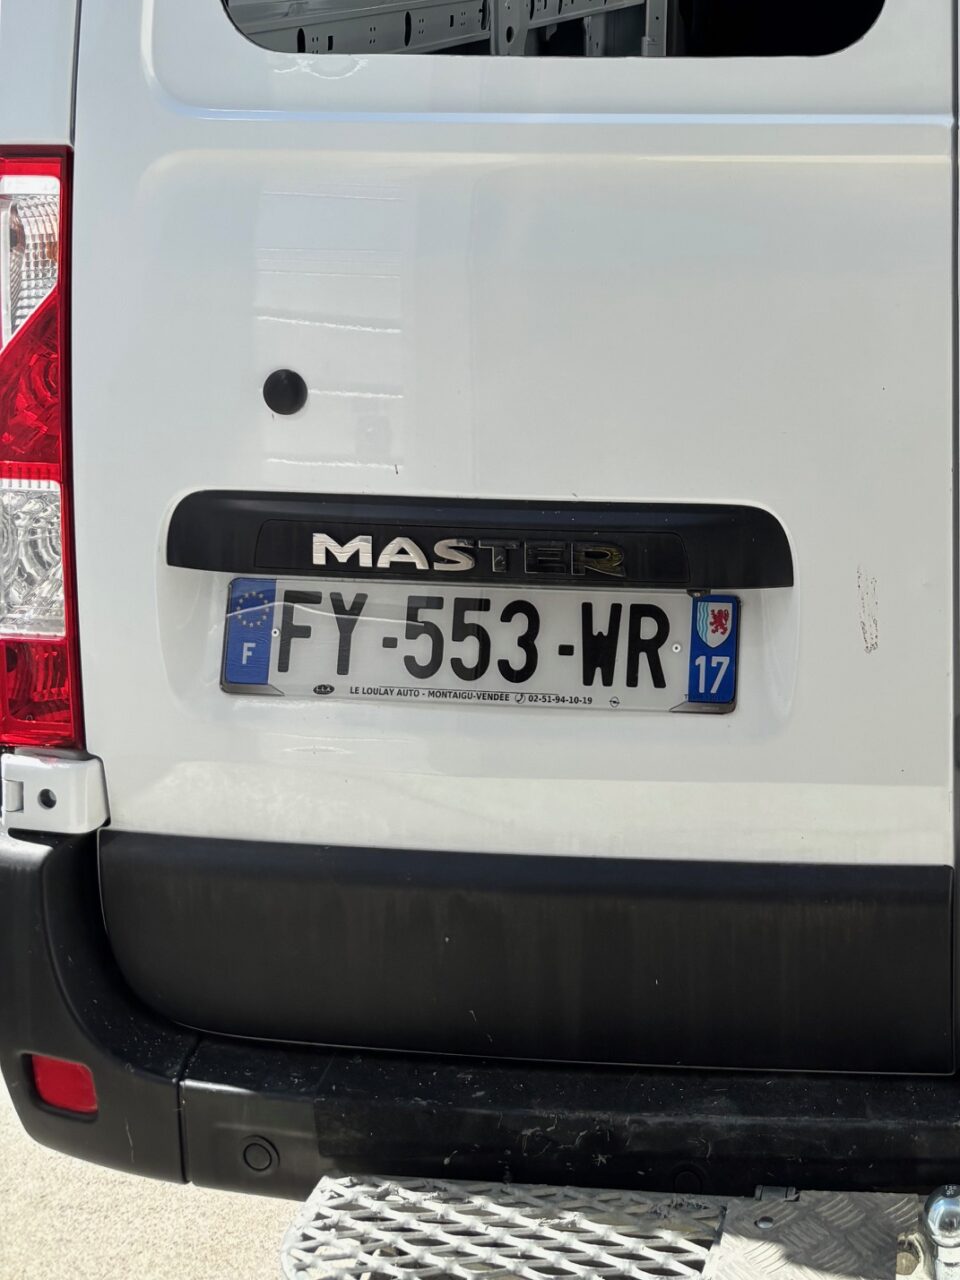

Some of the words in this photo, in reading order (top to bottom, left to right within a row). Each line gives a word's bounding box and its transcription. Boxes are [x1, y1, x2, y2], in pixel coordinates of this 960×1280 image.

[312, 532, 626, 577] MASTER
[241, 642, 256, 665] F
[277, 590, 670, 689] FY-553-WR
[695, 655, 730, 694] 17
[350, 686, 359, 695] LE
[362, 687, 395, 696] LOULAY
[396, 688, 420, 697] AUTO
[528, 694, 593, 704] 02-51-94-10-19
